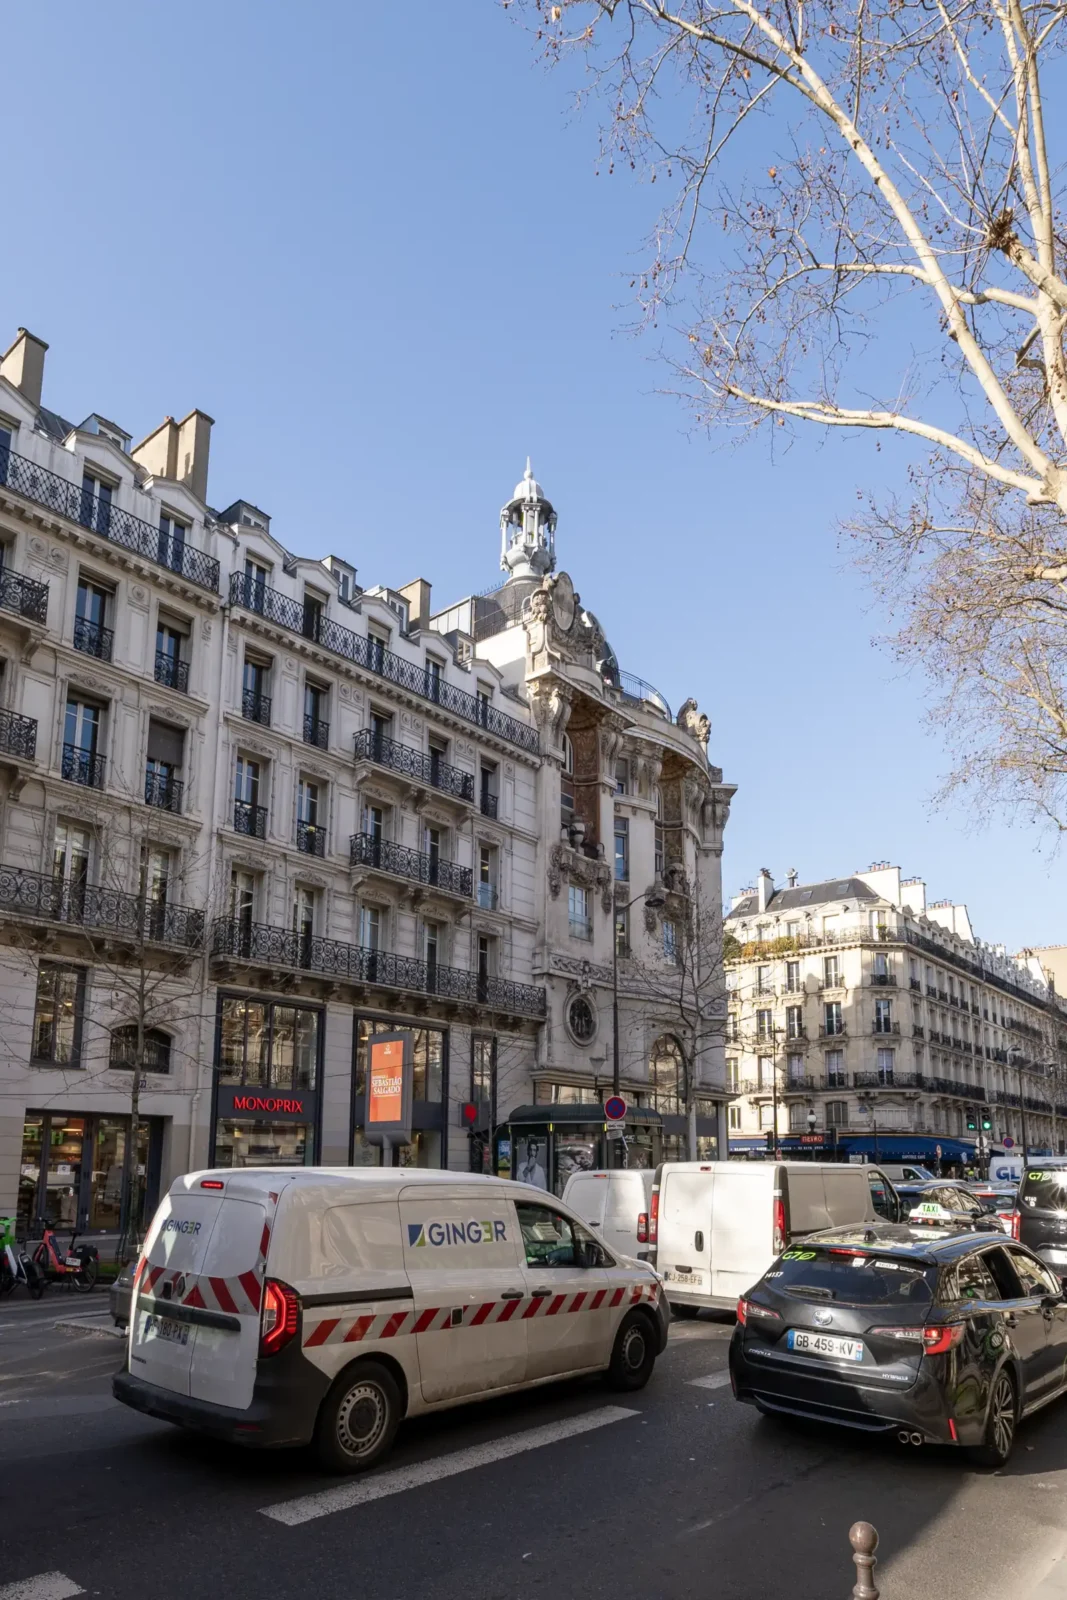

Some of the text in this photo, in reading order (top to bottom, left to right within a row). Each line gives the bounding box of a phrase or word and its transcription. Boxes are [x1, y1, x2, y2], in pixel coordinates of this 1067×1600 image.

[373, 1085, 401, 1095] SALGADO
[234, 1096, 303, 1114] MONOPRIX
[1028, 1172, 1042, 1180] G7
[922, 1204, 939, 1213] TAXI
[166, 1219, 202, 1235] GINGER
[428, 1220, 507, 1246] GINGER
[782, 1251, 802, 1261] G7
[796, 1334, 854, 1356] GB-459-KV
